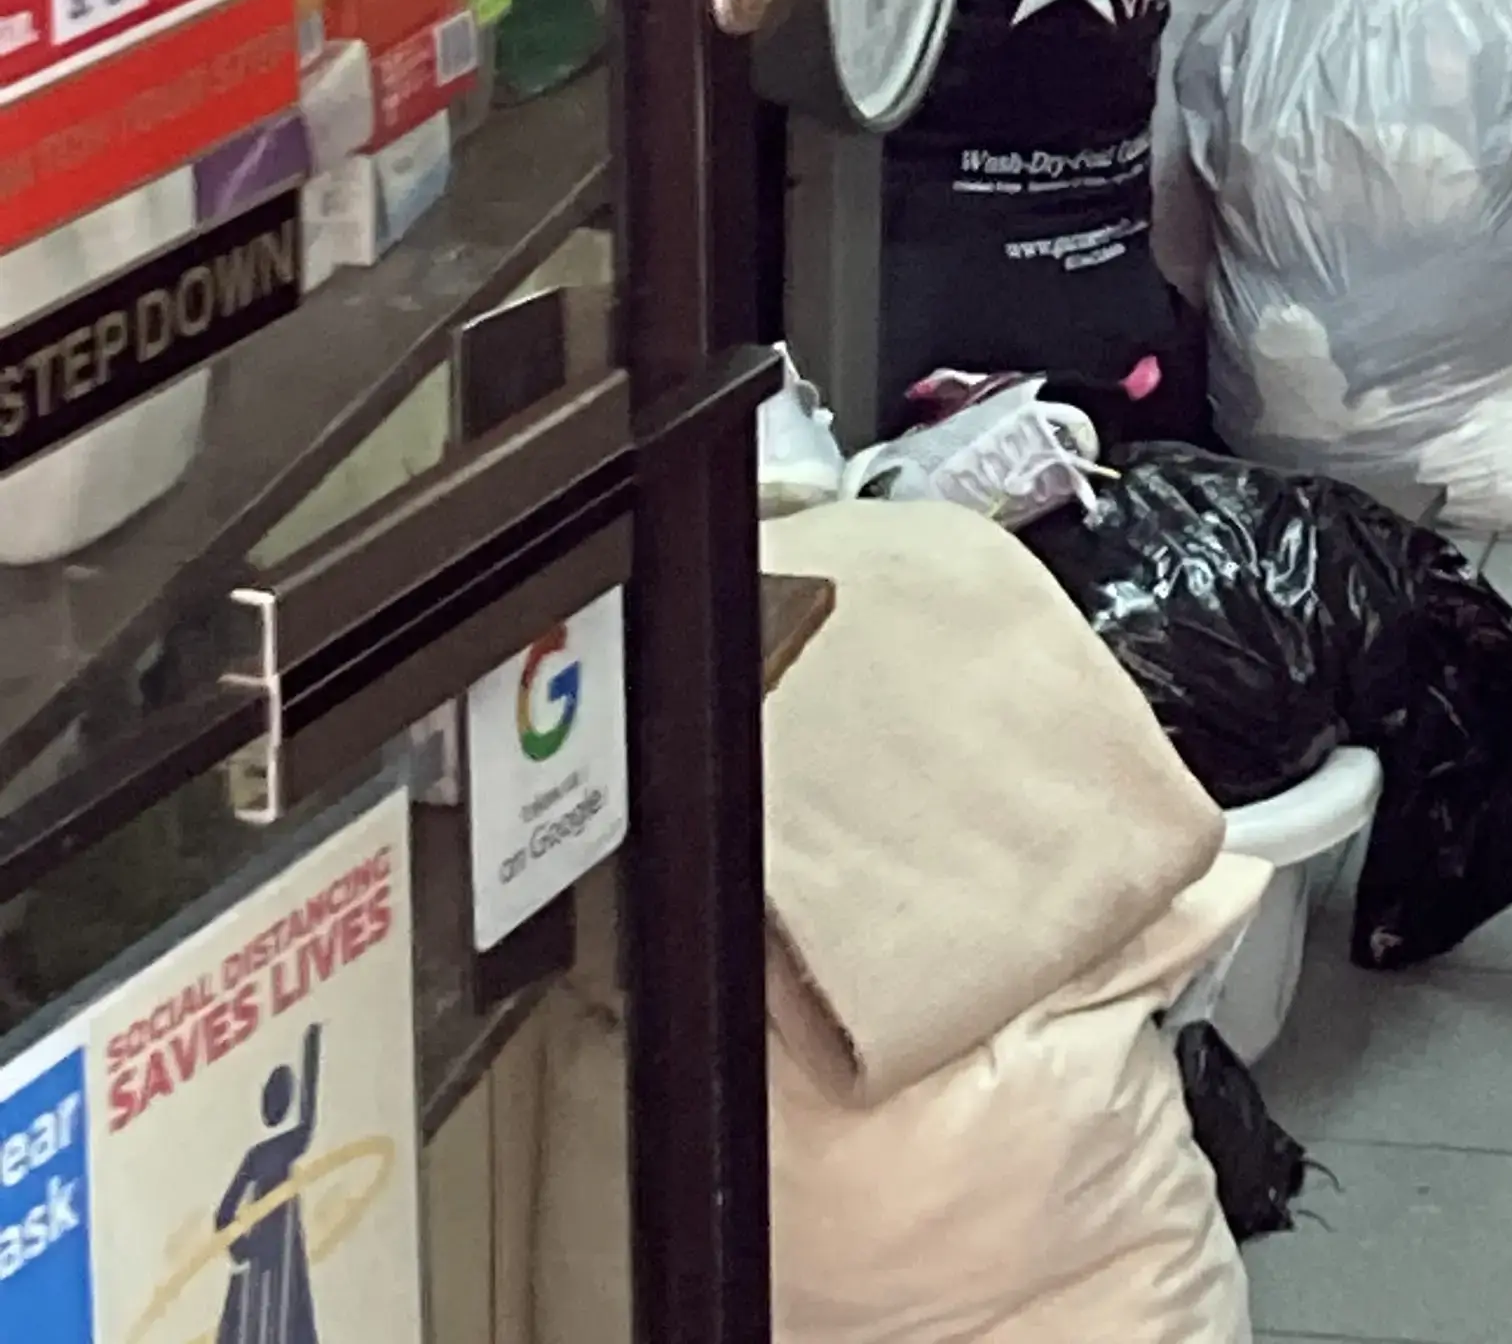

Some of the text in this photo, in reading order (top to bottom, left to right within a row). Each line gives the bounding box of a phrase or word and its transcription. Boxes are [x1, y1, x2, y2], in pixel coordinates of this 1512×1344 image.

[0, 218, 297, 437] STEP DOWN
[528, 784, 608, 860] Google
[106, 844, 394, 1067] SOCIAL DISTANCING
[108, 885, 393, 1135] SAVES LIVES
